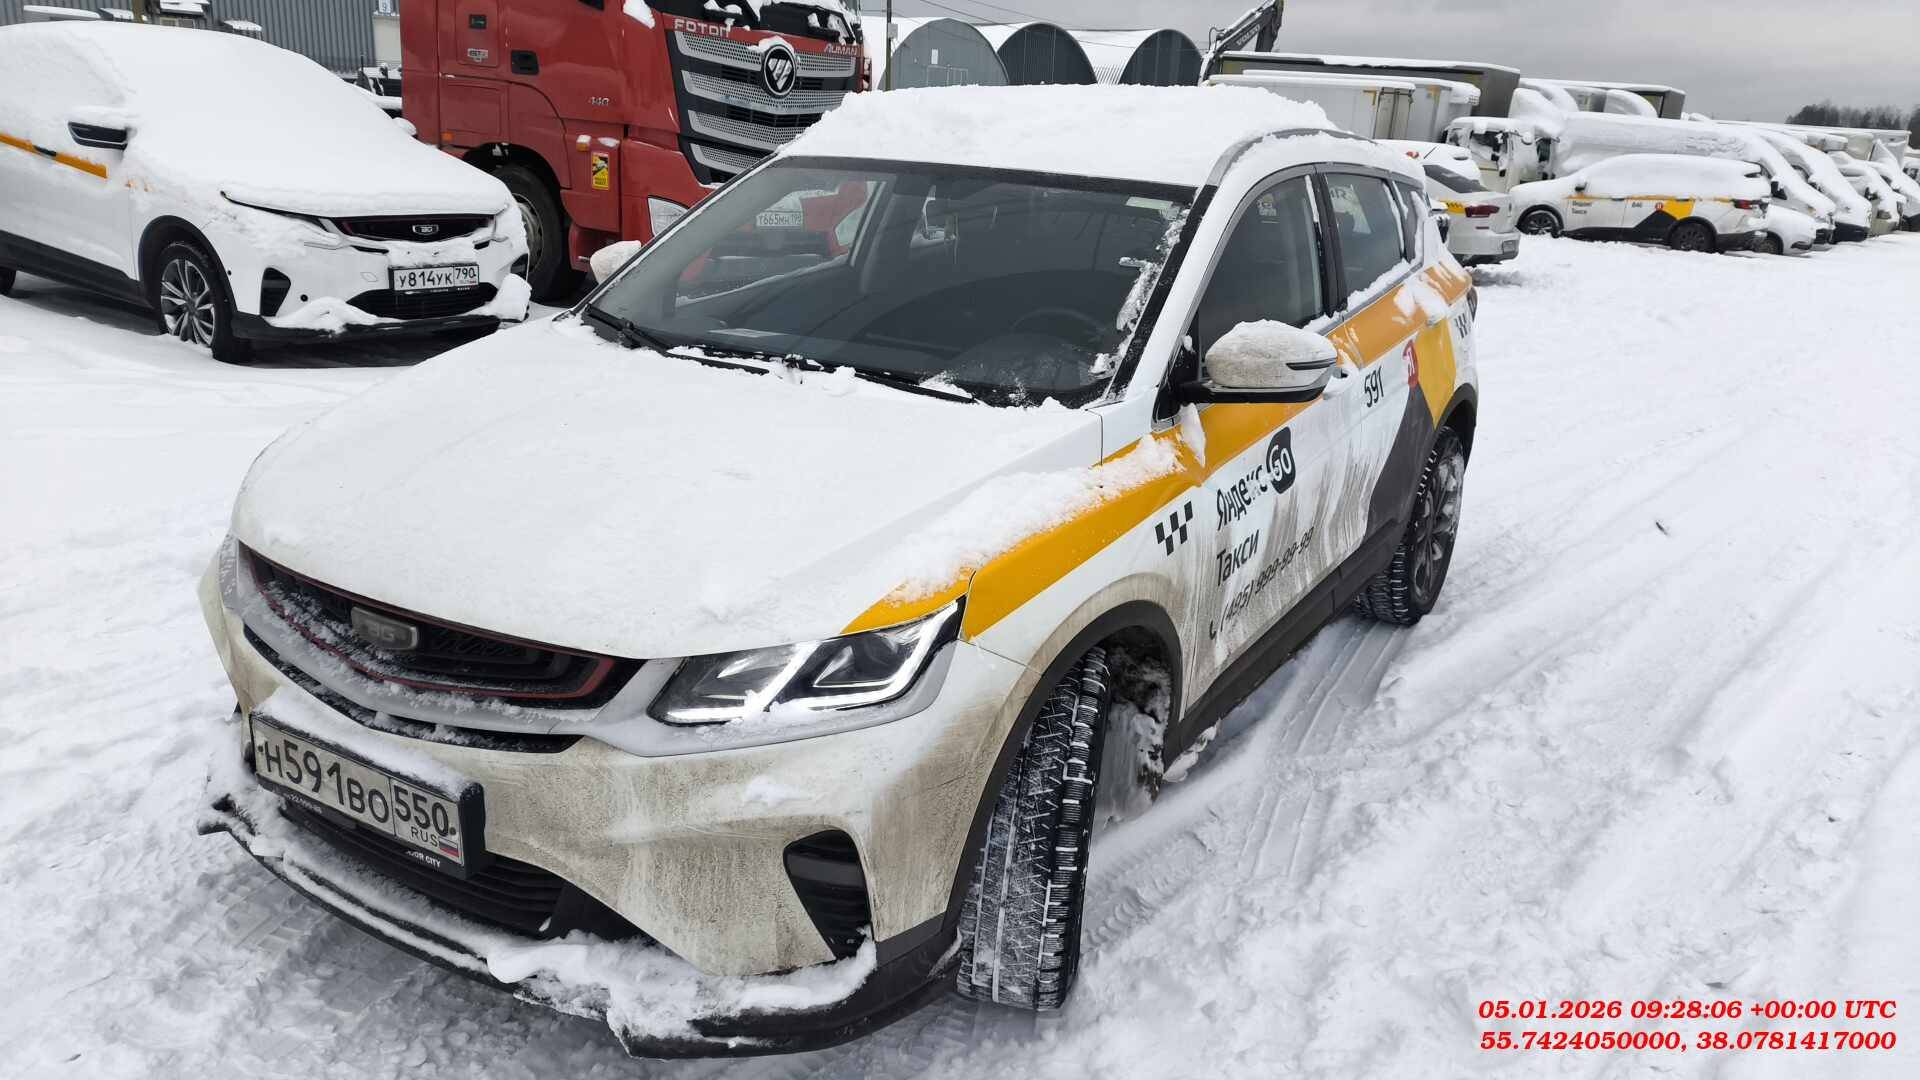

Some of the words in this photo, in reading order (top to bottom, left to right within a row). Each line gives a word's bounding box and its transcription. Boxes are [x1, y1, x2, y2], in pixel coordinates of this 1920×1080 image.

[674, 18, 731, 37] FOTON
[399, 270, 453, 288] У814УК
[455, 267, 476, 280] 790
[1364, 365, 1384, 408] 591
[1216, 529, 1260, 587] Такси
[1220, 580, 1254, 633] (495)
[1254, 526, 1315, 596] 999-99-99
[264, 739, 390, 824] Н591ВО
[392, 784, 450, 838] 550
[410, 826, 438, 848] RUS
